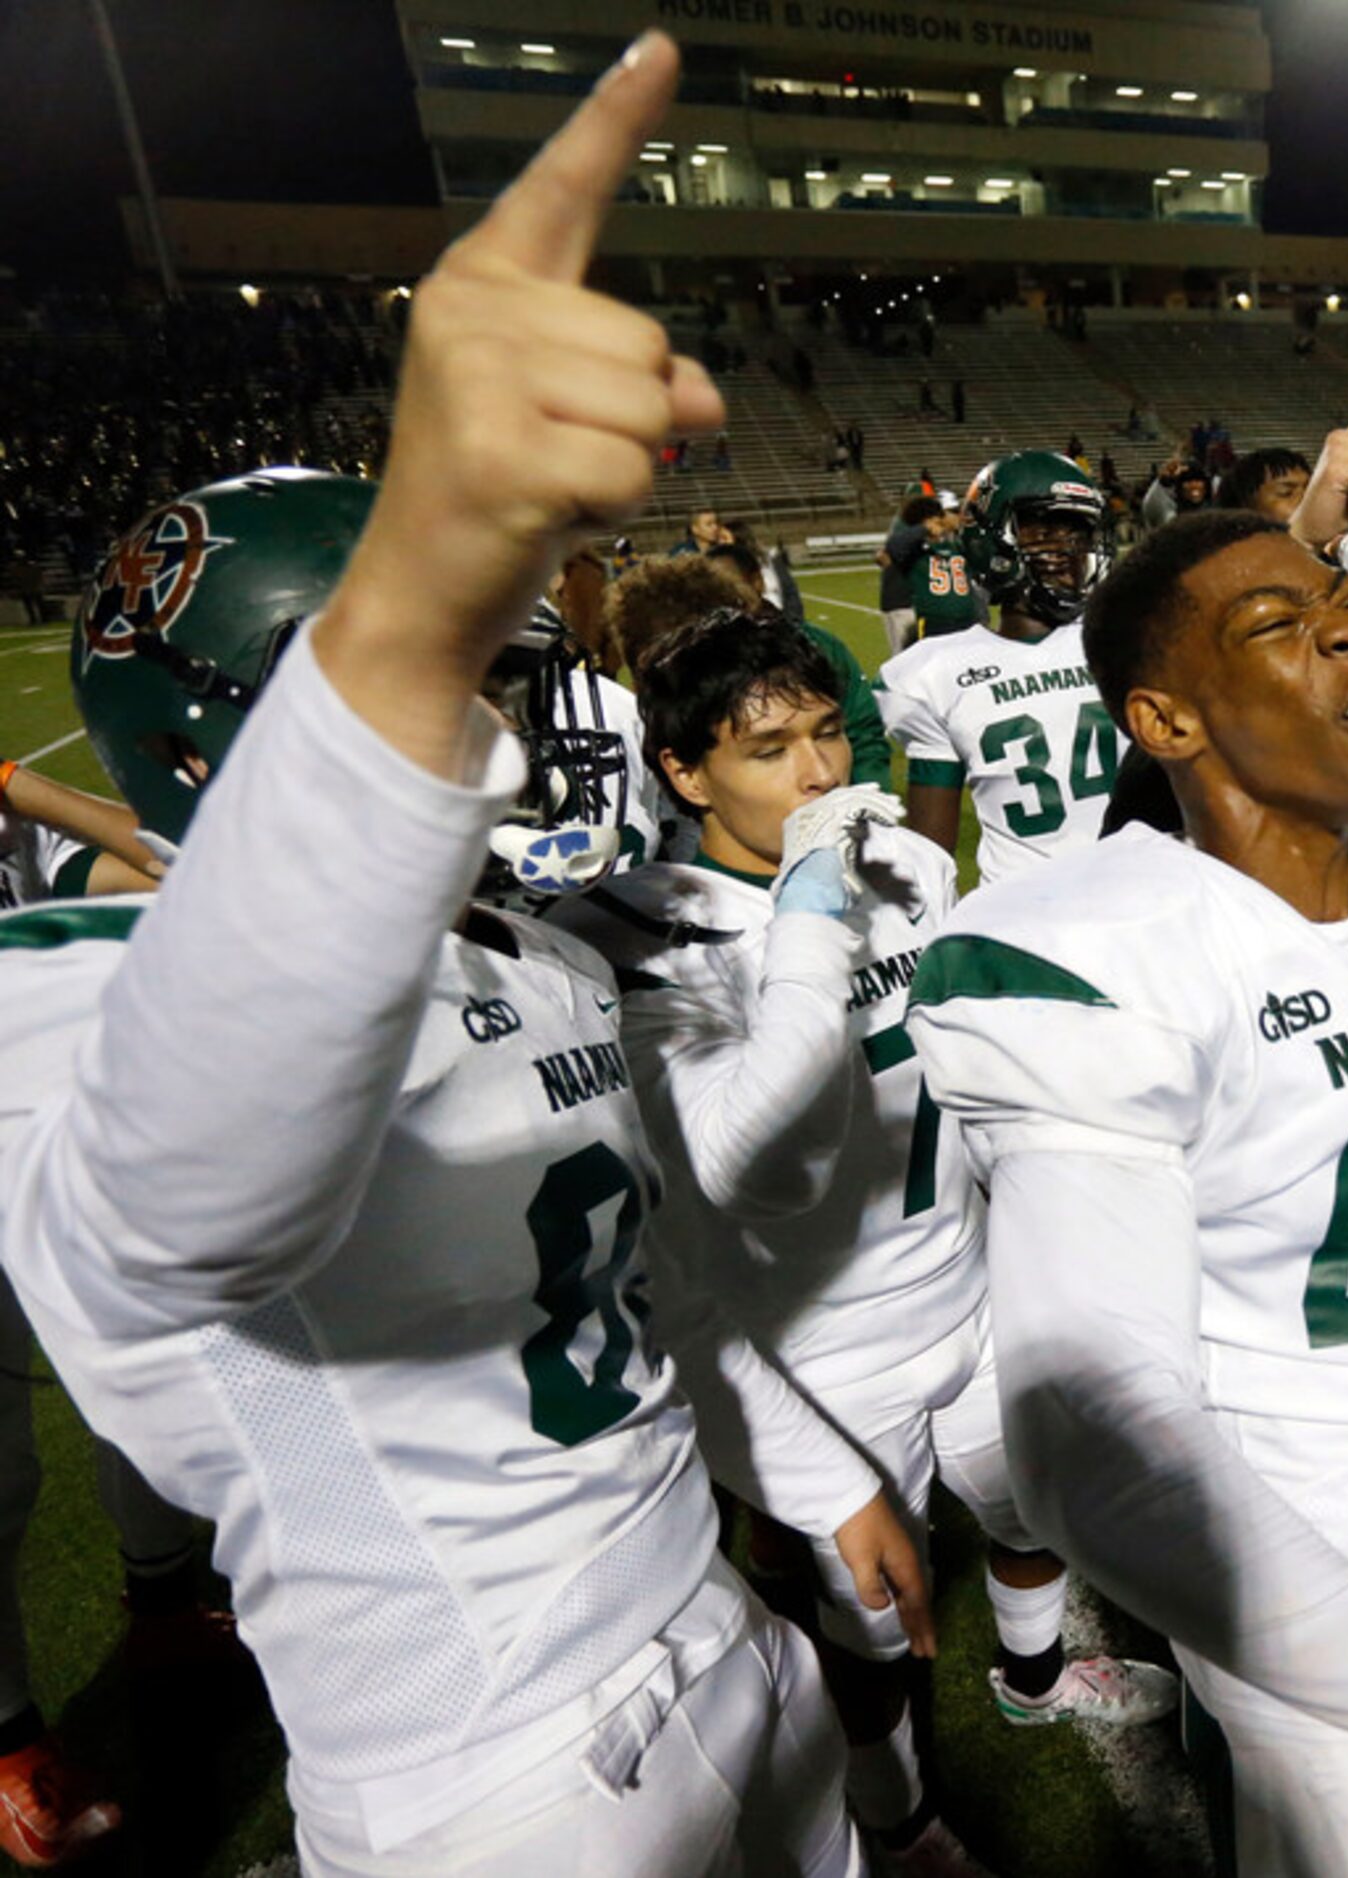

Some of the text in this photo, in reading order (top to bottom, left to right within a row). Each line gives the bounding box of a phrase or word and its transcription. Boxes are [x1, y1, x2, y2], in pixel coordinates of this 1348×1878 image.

[658, 0, 772, 23] HOMER
[816, 7, 963, 43] JOHNSON
[972, 19, 1093, 54] STADIUM
[979, 700, 1119, 838] 34
[521, 1138, 664, 1449] 8
